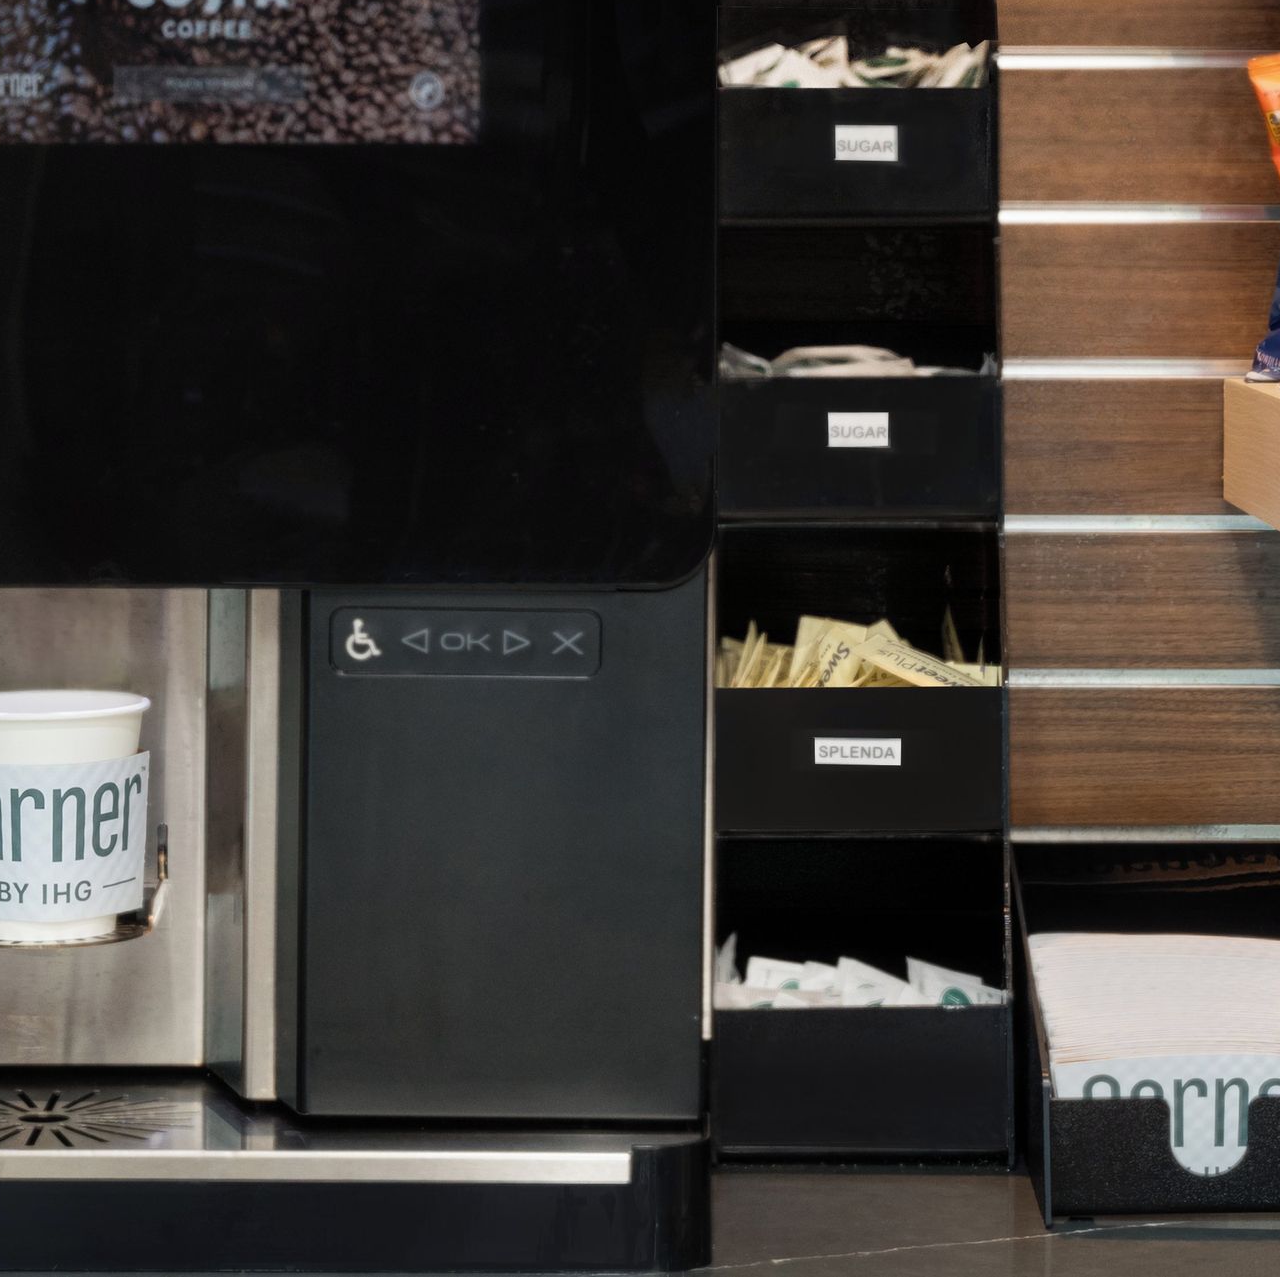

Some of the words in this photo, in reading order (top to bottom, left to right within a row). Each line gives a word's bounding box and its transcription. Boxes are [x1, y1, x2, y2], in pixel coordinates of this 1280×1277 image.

[161, 19, 252, 40] COFFEE
[836, 139, 894, 153] SUGAR
[830, 425, 887, 439] SUGAR
[440, 632, 491, 651] OK
[818, 744, 896, 760] SPLENDA
[42, 880, 92, 905] IHG
